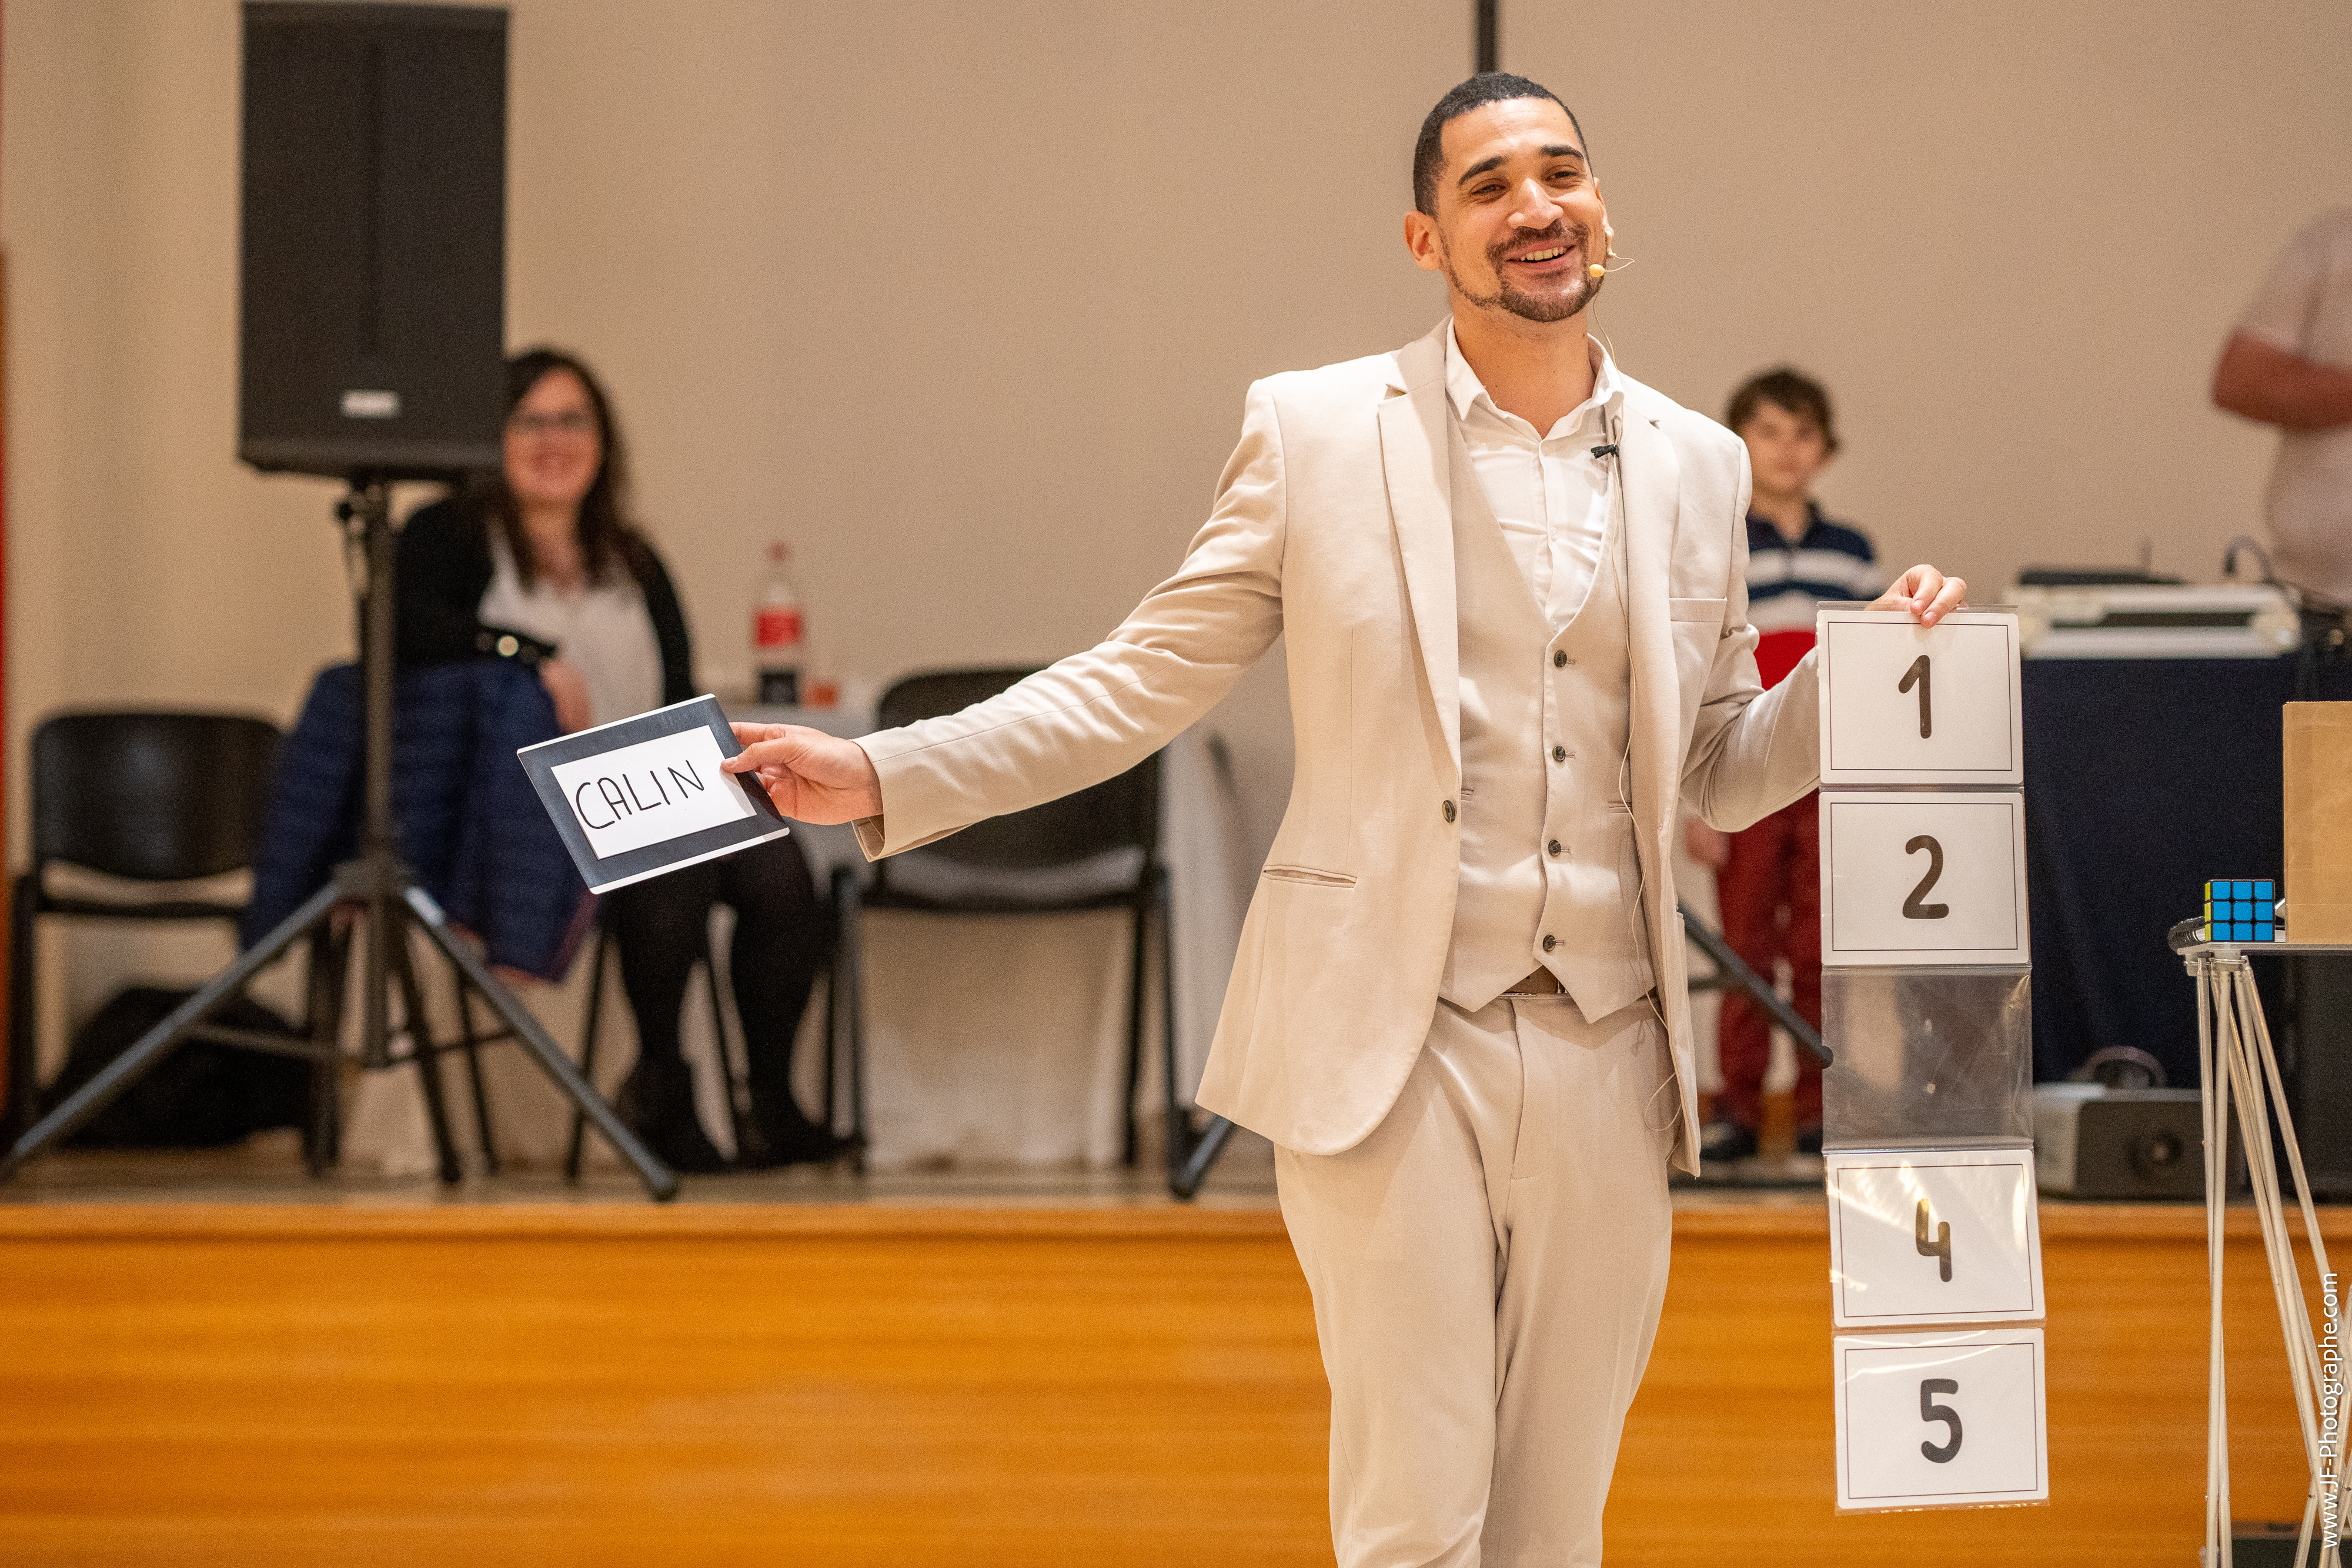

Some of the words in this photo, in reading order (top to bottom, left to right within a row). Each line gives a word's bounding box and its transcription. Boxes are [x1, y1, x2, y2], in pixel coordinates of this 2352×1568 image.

[1898, 655, 1932, 738] 1
[576, 760, 704, 829] CALIN
[1902, 835, 1949, 919] 2
[1916, 1198, 1953, 1282] 4
[1920, 1379, 1963, 1463] 5
